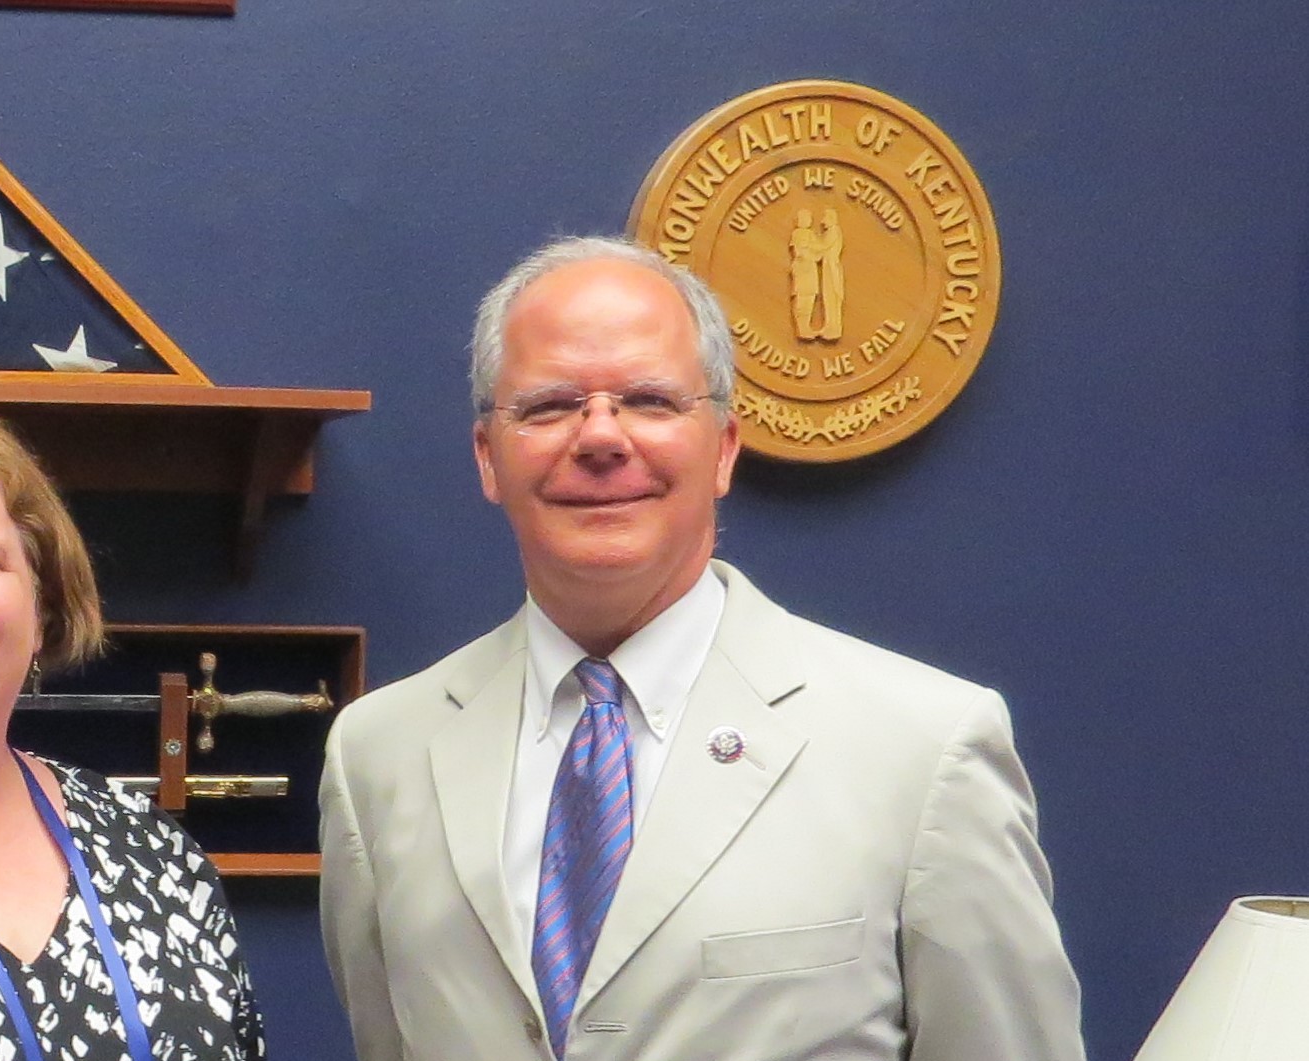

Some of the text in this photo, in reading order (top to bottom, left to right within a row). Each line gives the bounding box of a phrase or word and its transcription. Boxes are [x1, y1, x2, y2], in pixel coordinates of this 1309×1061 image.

[728, 168, 906, 233] UNITED WE STAND
[855, 114, 903, 155] OF
[906, 149, 981, 357] KENTUCKY
[730, 317, 906, 381] DIVIDED WE FALL
